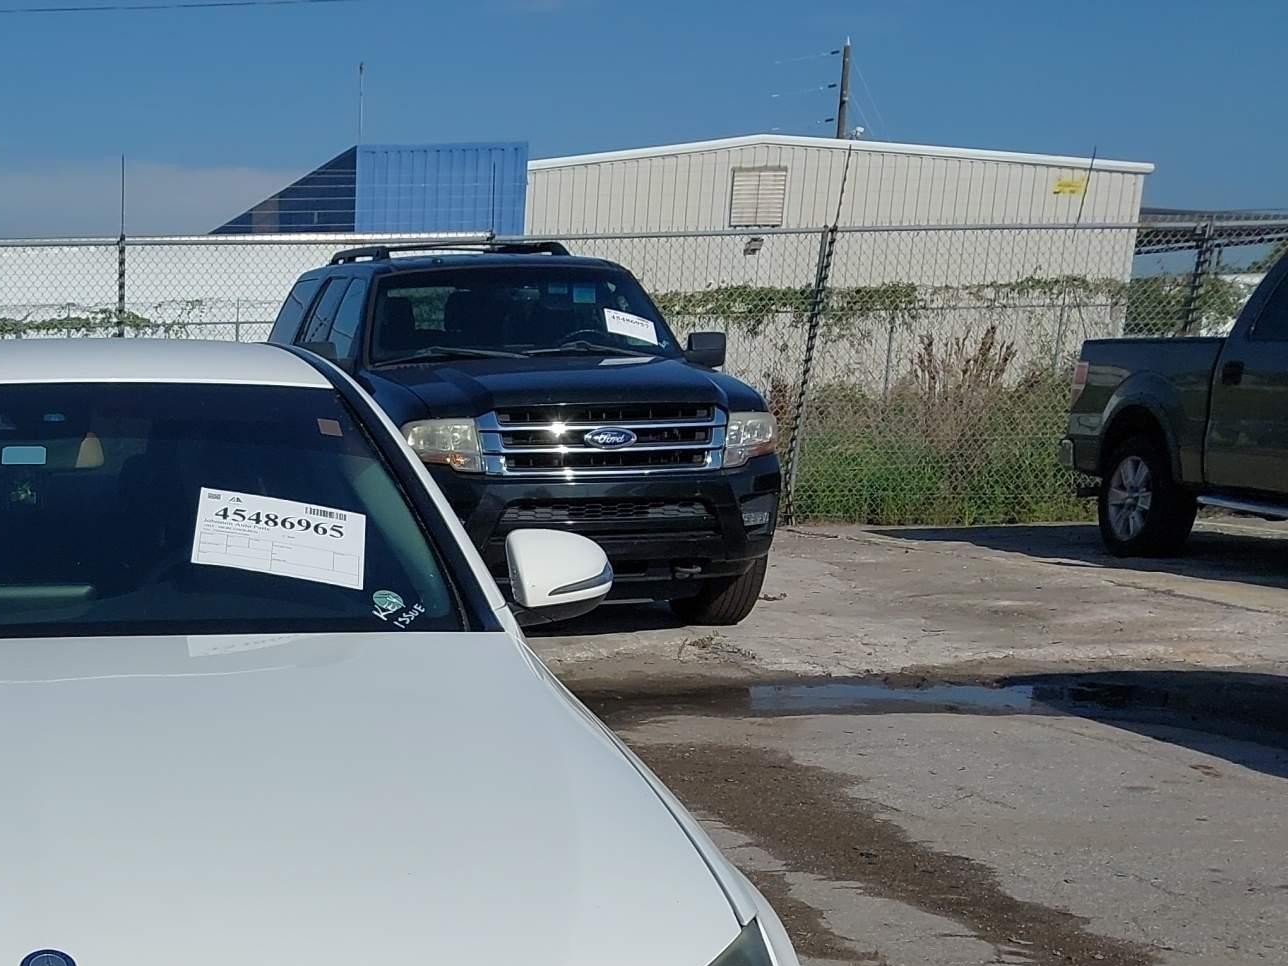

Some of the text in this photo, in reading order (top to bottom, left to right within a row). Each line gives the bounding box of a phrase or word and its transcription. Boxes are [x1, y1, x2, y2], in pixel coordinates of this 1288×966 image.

[593, 431, 625, 444] Ford
[214, 506, 344, 539] 45486965
[393, 603, 425, 629] ISSUE
